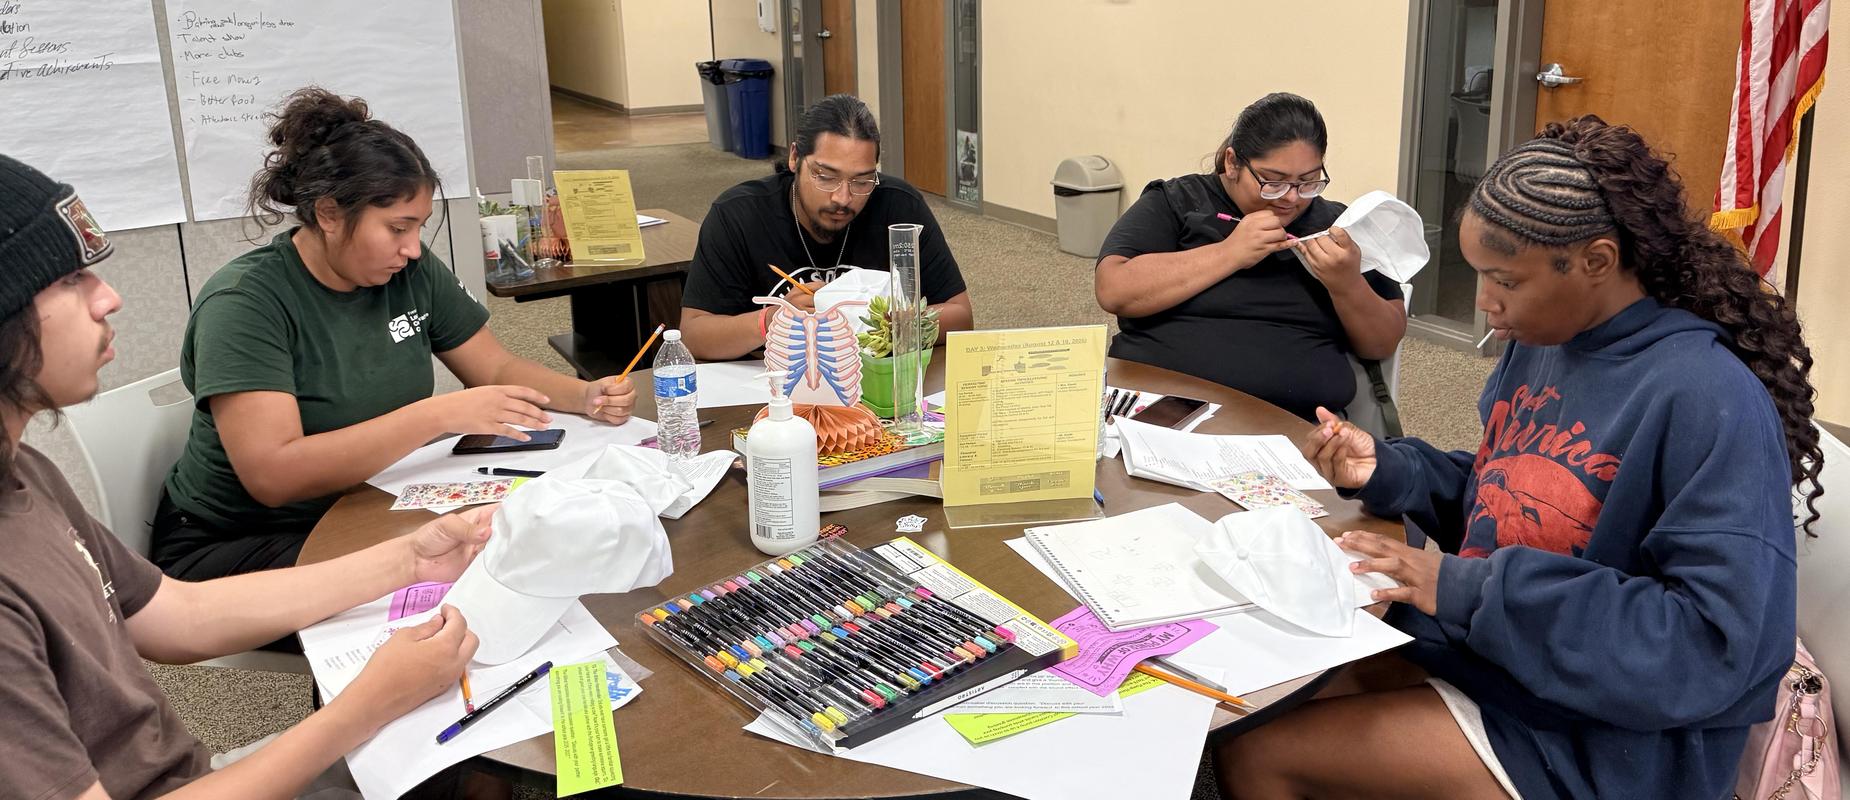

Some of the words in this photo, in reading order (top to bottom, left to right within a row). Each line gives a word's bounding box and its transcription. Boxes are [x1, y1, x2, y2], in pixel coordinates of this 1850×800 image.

[184, 50, 212, 62] More
[218, 47, 245, 59] clubs
[192, 71, 221, 86] Free
[200, 93, 230, 106] Better
[1155, 632, 1175, 645] MY
[1096, 653, 1118, 677] WHY
[957, 686, 986, 700] ARTISTRO
